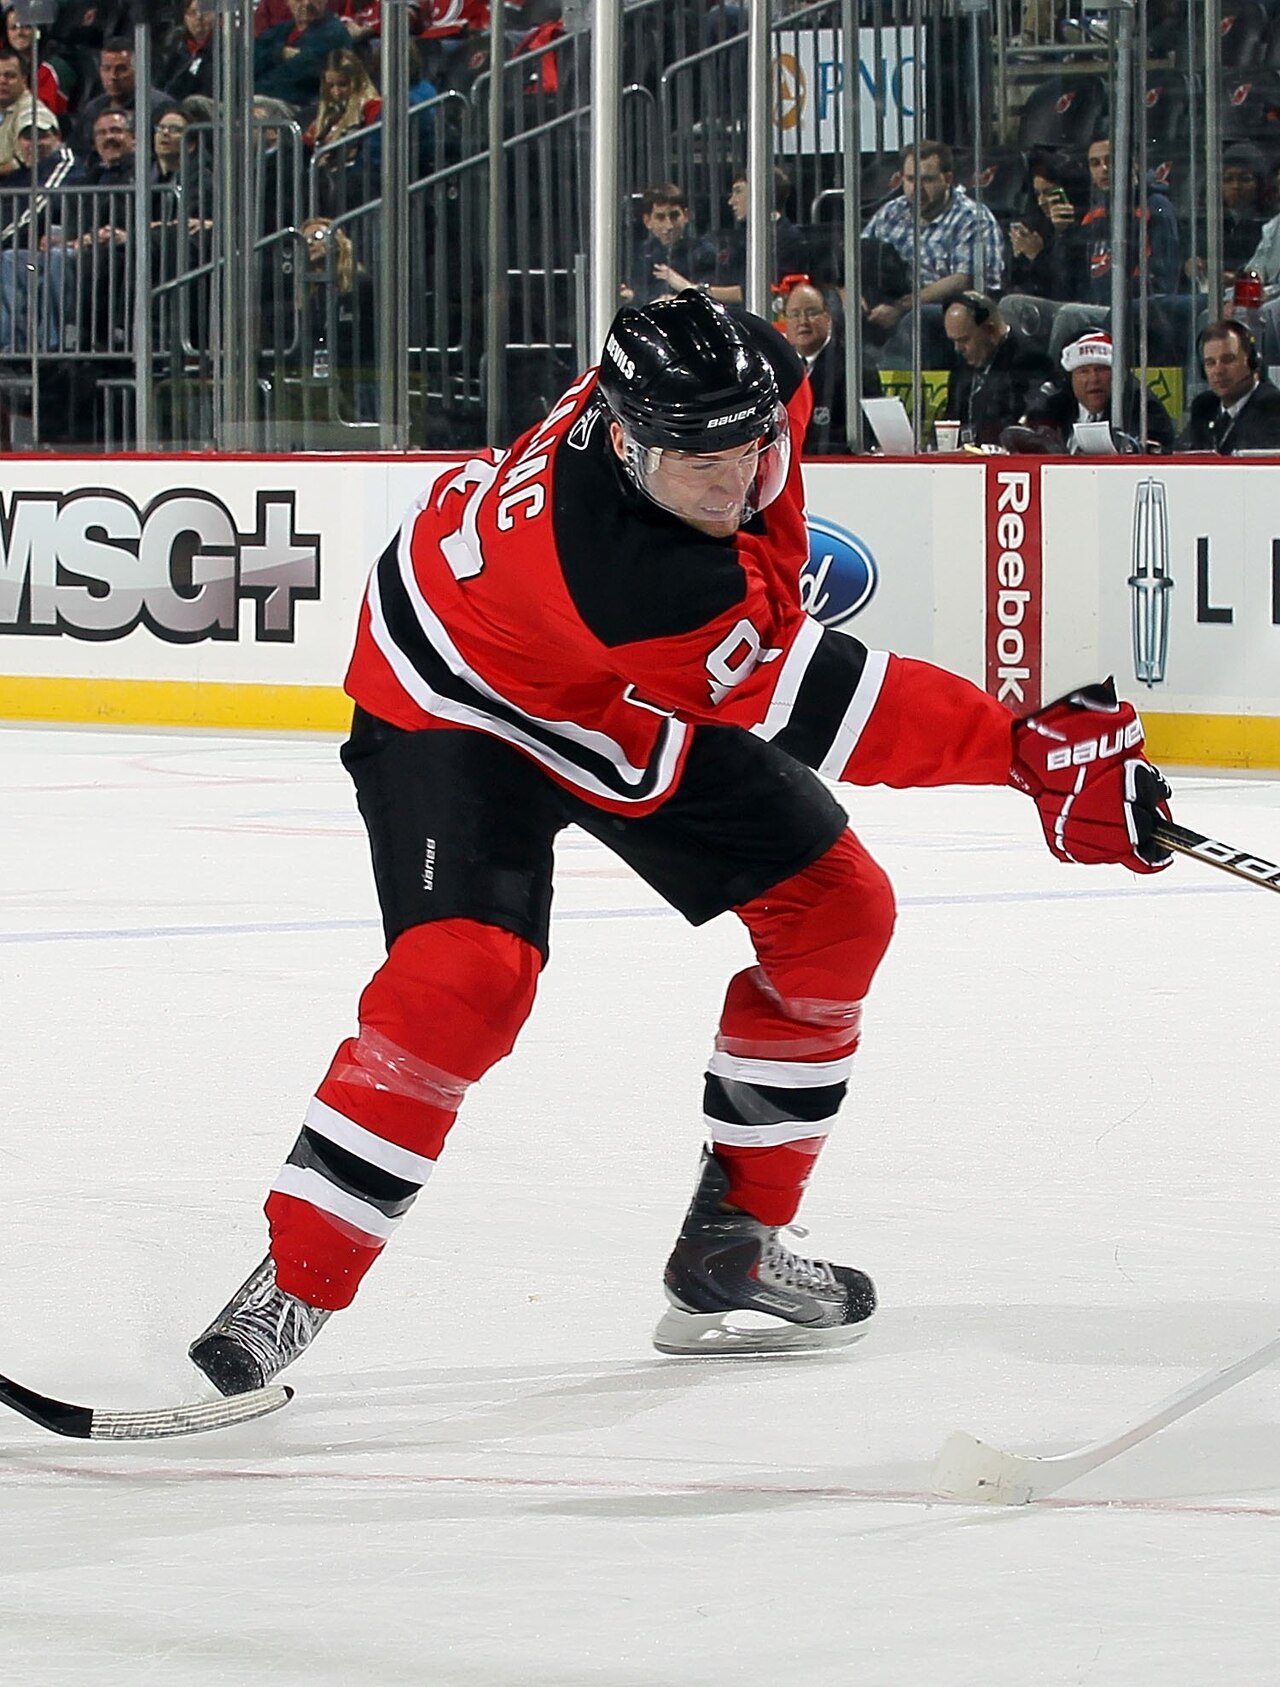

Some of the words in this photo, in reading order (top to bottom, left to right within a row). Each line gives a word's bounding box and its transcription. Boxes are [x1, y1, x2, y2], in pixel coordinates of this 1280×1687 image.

[817, 56, 926, 120] PNC
[606, 333, 635, 380] DEVILS
[707, 407, 757, 428] BAUER
[997, 472, 1030, 703] Reebok
[1047, 718, 1144, 771] BAUE
[423, 838, 436, 891] BAUER
